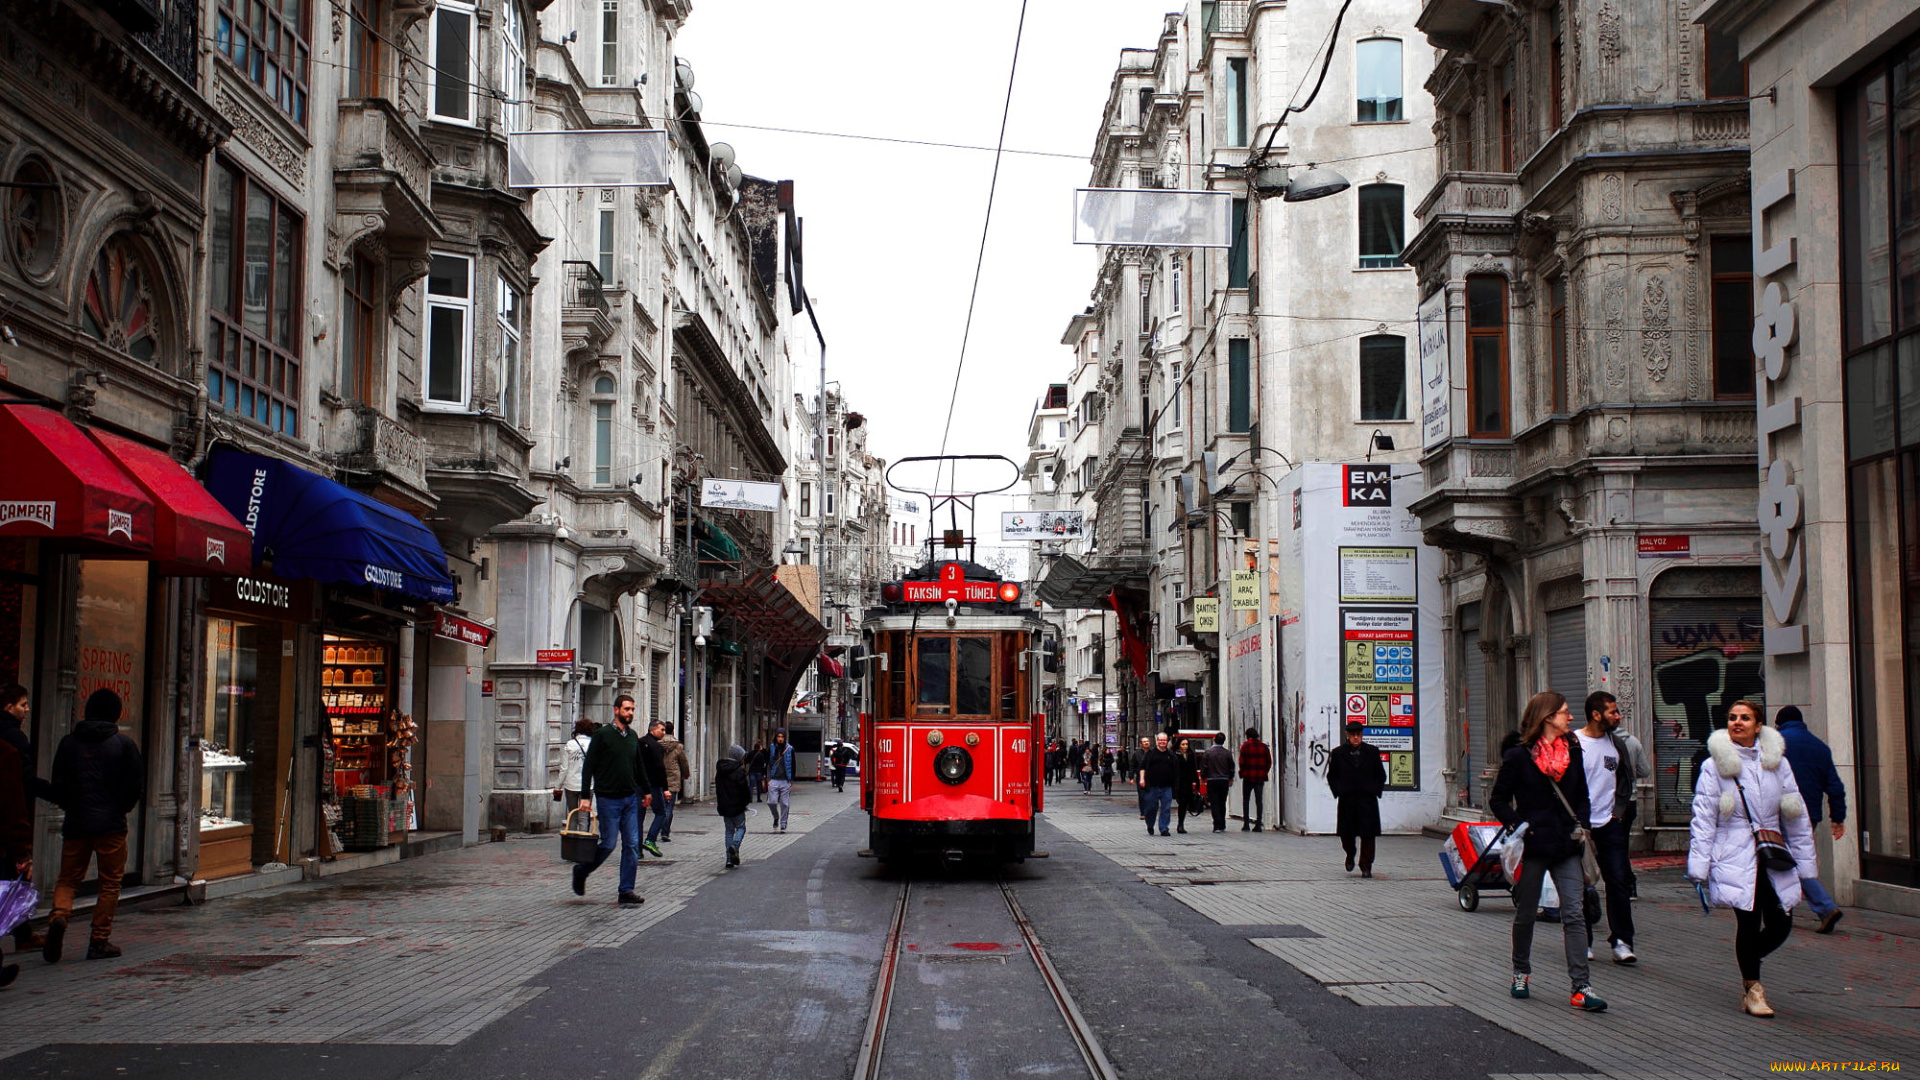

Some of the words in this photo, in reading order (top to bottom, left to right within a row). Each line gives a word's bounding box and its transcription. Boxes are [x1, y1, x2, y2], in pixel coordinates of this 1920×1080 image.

[1351, 471, 1387, 484] EM
[1351, 488, 1387, 500] KA
[245, 469, 266, 543] OLDSTORE
[0, 504, 52, 523] CAMPER
[365, 564, 403, 589] GOLDSTORE
[948, 566, 956, 580] 3
[237, 577, 289, 608] GOLDSTORE
[965, 585, 997, 600] TÜNEL
[1238, 586, 1253, 594] ARAÇ
[1196, 603, 1217, 614] ŞANTİYE
[82, 648, 132, 675] SPRING
[878, 739, 892, 753] 410
[1011, 739, 1026, 753] 410
